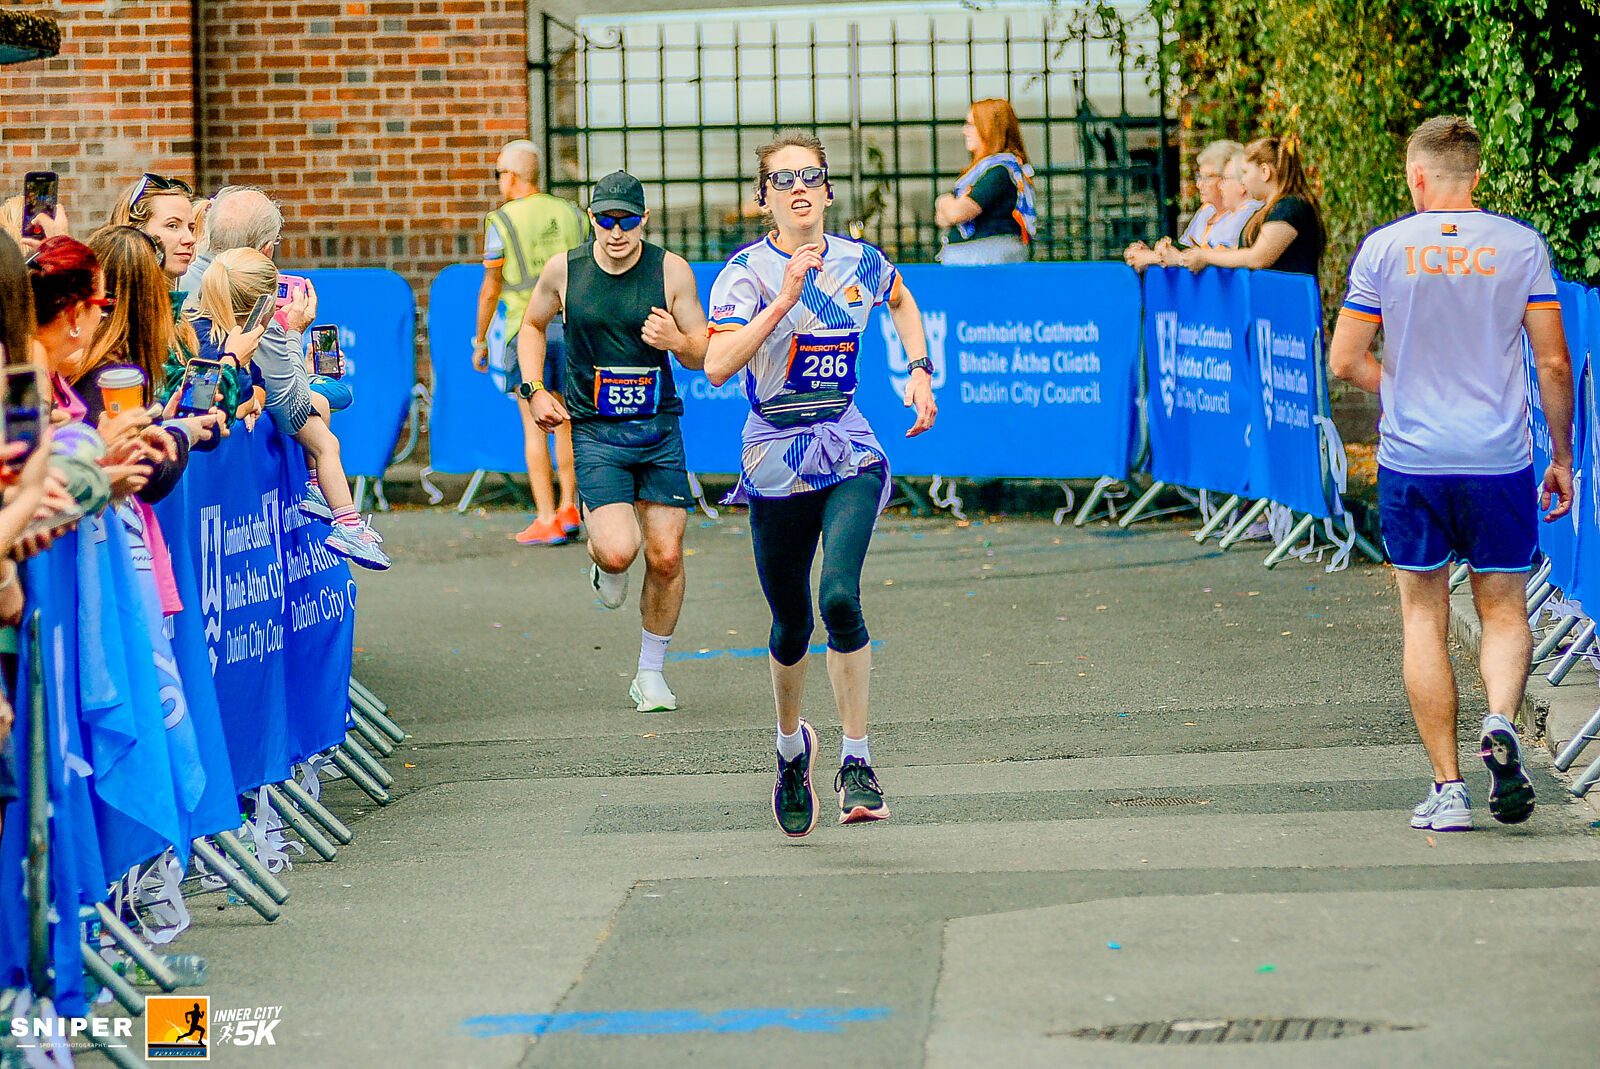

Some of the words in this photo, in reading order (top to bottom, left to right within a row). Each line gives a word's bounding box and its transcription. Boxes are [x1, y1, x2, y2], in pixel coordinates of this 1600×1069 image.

[1405, 245, 1496, 275] ICRC
[1034, 320, 1099, 344] Cathrach
[802, 354, 848, 378] 286
[959, 351, 1008, 374] Bhaile
[1011, 346, 1050, 374] Átha
[1052, 351, 1100, 374] Cliath
[608, 386, 646, 405] 533
[690, 377, 741, 400] Coun
[960, 381, 1008, 404] Dublin
[1010, 381, 1042, 408] City
[1043, 381, 1101, 404] Council
[1197, 387, 1230, 414] Council
[246, 560, 269, 605] Átha
[291, 593, 320, 632] Dublin
[320, 586, 344, 622] City
[226, 625, 248, 664] Dublin
[249, 620, 265, 662] City
[266, 618, 284, 653] Coun
